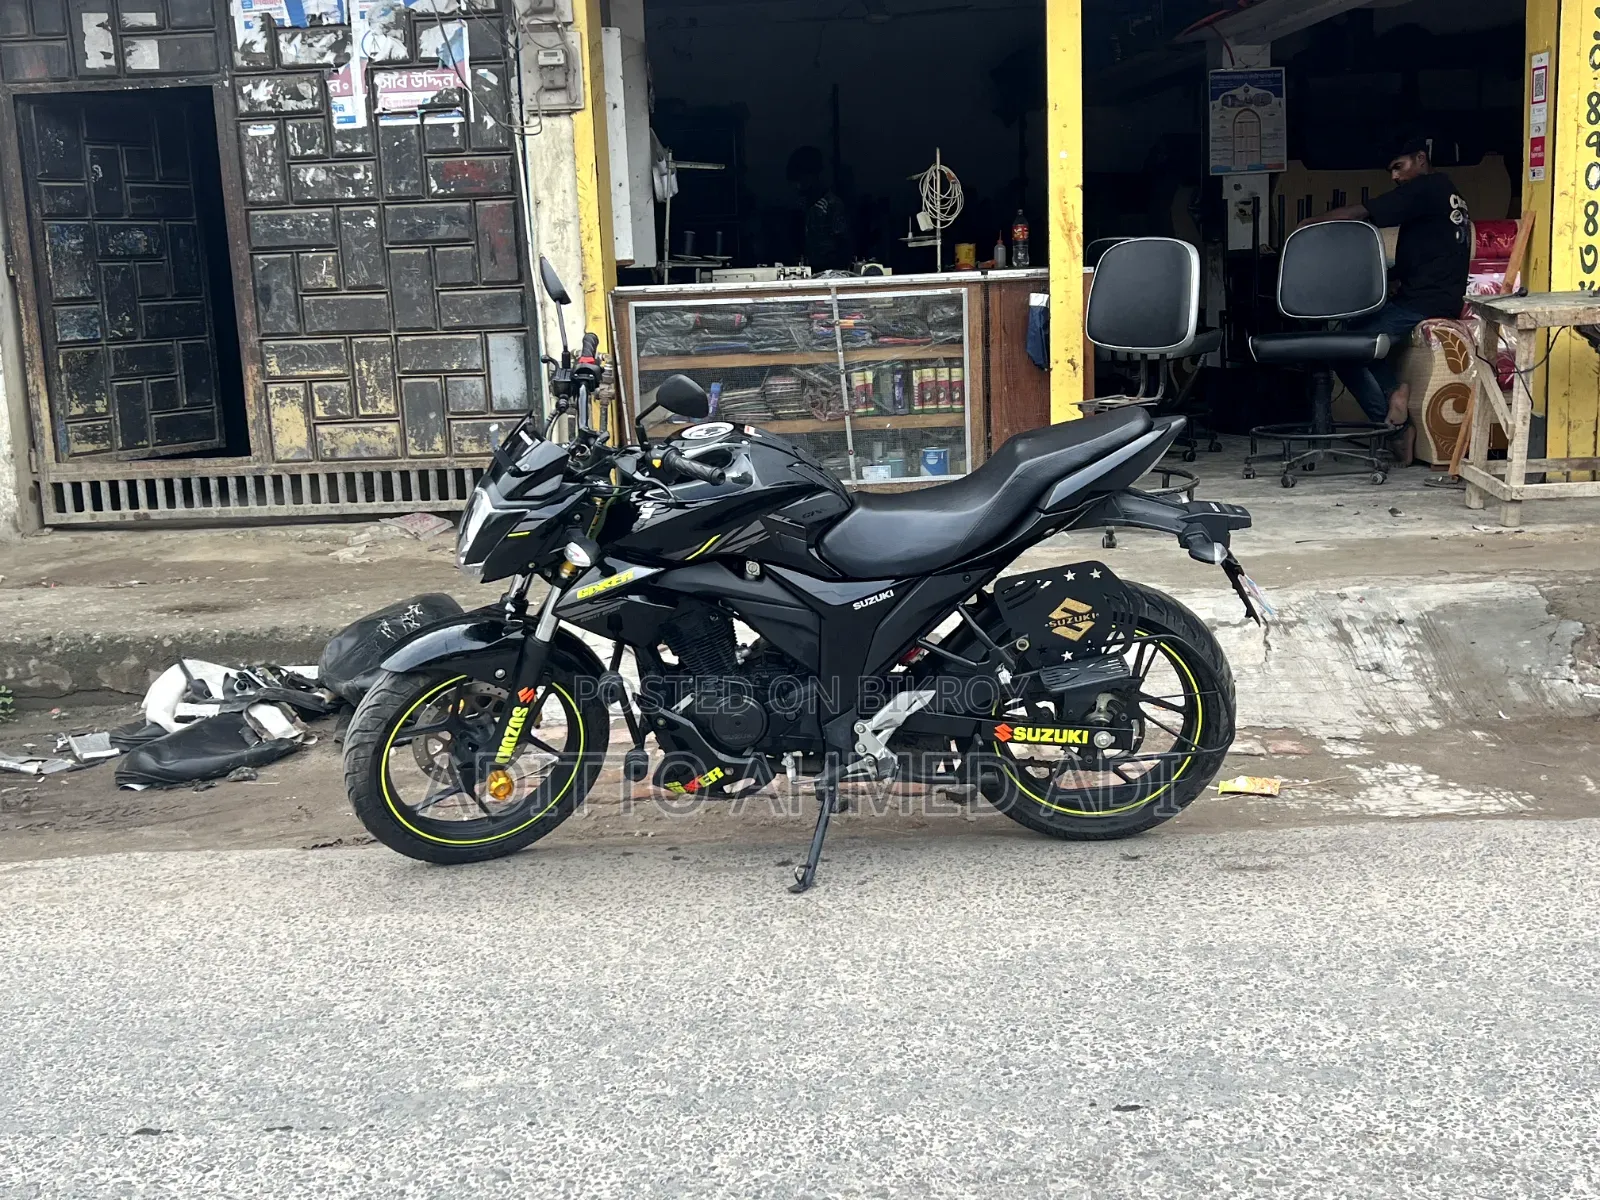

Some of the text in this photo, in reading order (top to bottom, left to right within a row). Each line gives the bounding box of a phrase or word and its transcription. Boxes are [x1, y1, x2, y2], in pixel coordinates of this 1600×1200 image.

[853, 590, 894, 610] SUZUKI
[1049, 612, 1095, 628] SUZUKI
[495, 706, 528, 764] SUZUKI
[1013, 727, 1089, 744] SUZUKI
